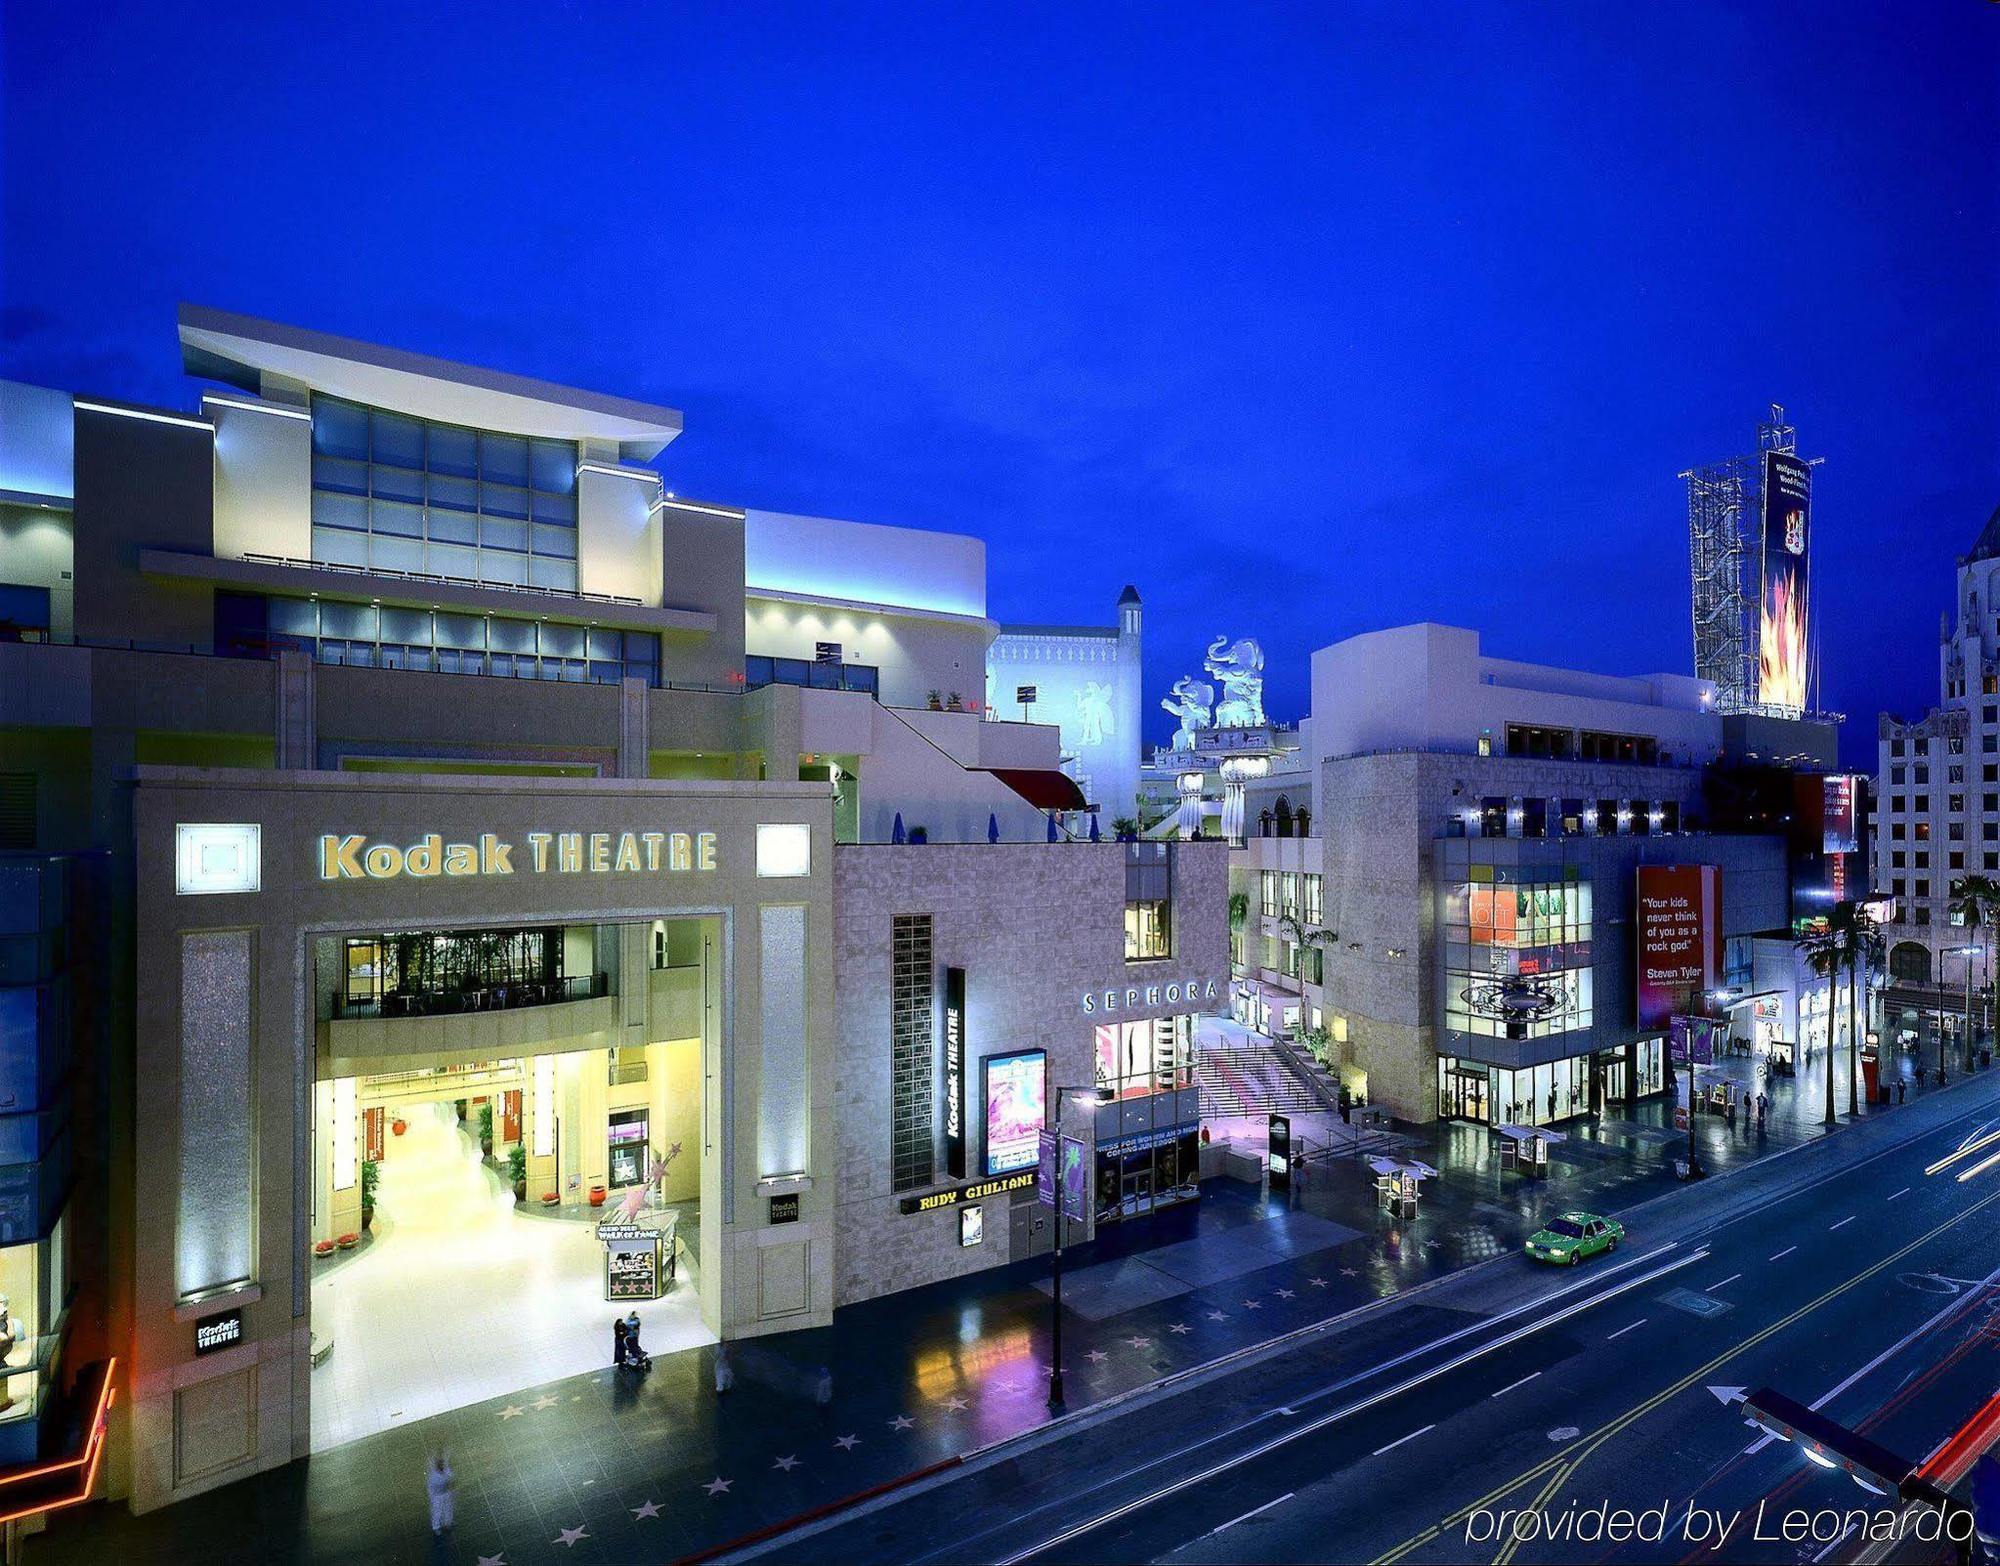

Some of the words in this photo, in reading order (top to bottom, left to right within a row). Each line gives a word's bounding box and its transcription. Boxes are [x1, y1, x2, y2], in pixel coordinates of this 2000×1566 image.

[320, 834, 515, 880] Kodak
[527, 832, 718, 873] THEATRE
[1670, 897, 1688, 907] kids
[1647, 914, 1672, 923] never
[1675, 911, 1697, 921] think
[1647, 927, 1656, 937] of
[1659, 928, 1675, 939] you
[1678, 927, 1689, 936] as
[1691, 927, 1697, 935] a
[1647, 942, 1668, 952] rock
[1647, 968, 1678, 979] Steven
[1680, 966, 1702, 979] Tyler
[1083, 981, 1218, 1014] SEPHORA
[947, 1007, 960, 1072] THEATRE
[947, 1073, 960, 1138] Kodak
[920, 1191, 957, 1210] RUDY
[965, 1174, 1033, 1199] GIULIANI
[198, 1329, 239, 1348] THEATRE
